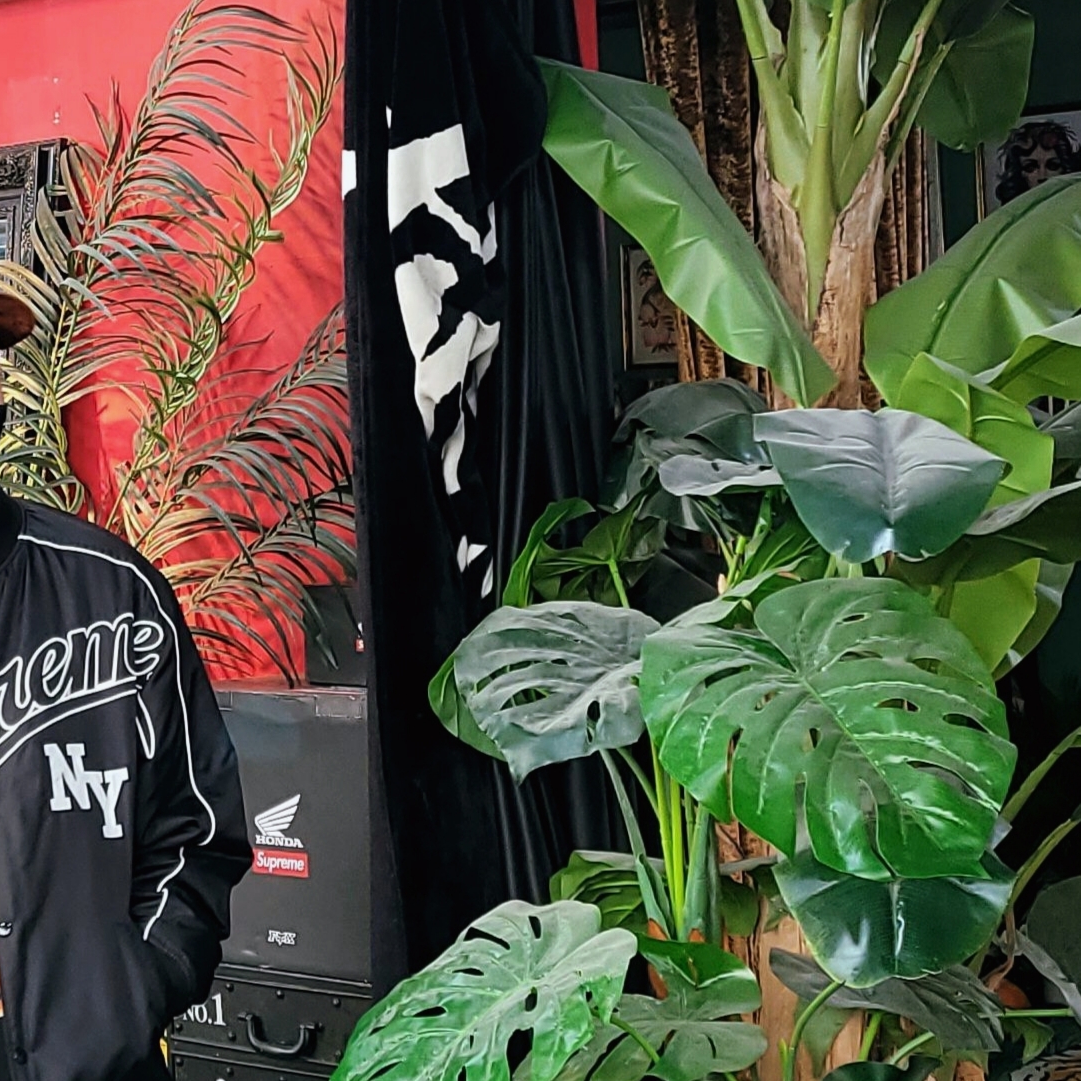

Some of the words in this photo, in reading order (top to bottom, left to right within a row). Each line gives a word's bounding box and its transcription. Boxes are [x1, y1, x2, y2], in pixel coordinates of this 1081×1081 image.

[43, 742, 129, 839] NY
[255, 834, 304, 849] HONDA
[256, 851, 305, 874] Supreme
[268, 929, 296, 946] FOX
